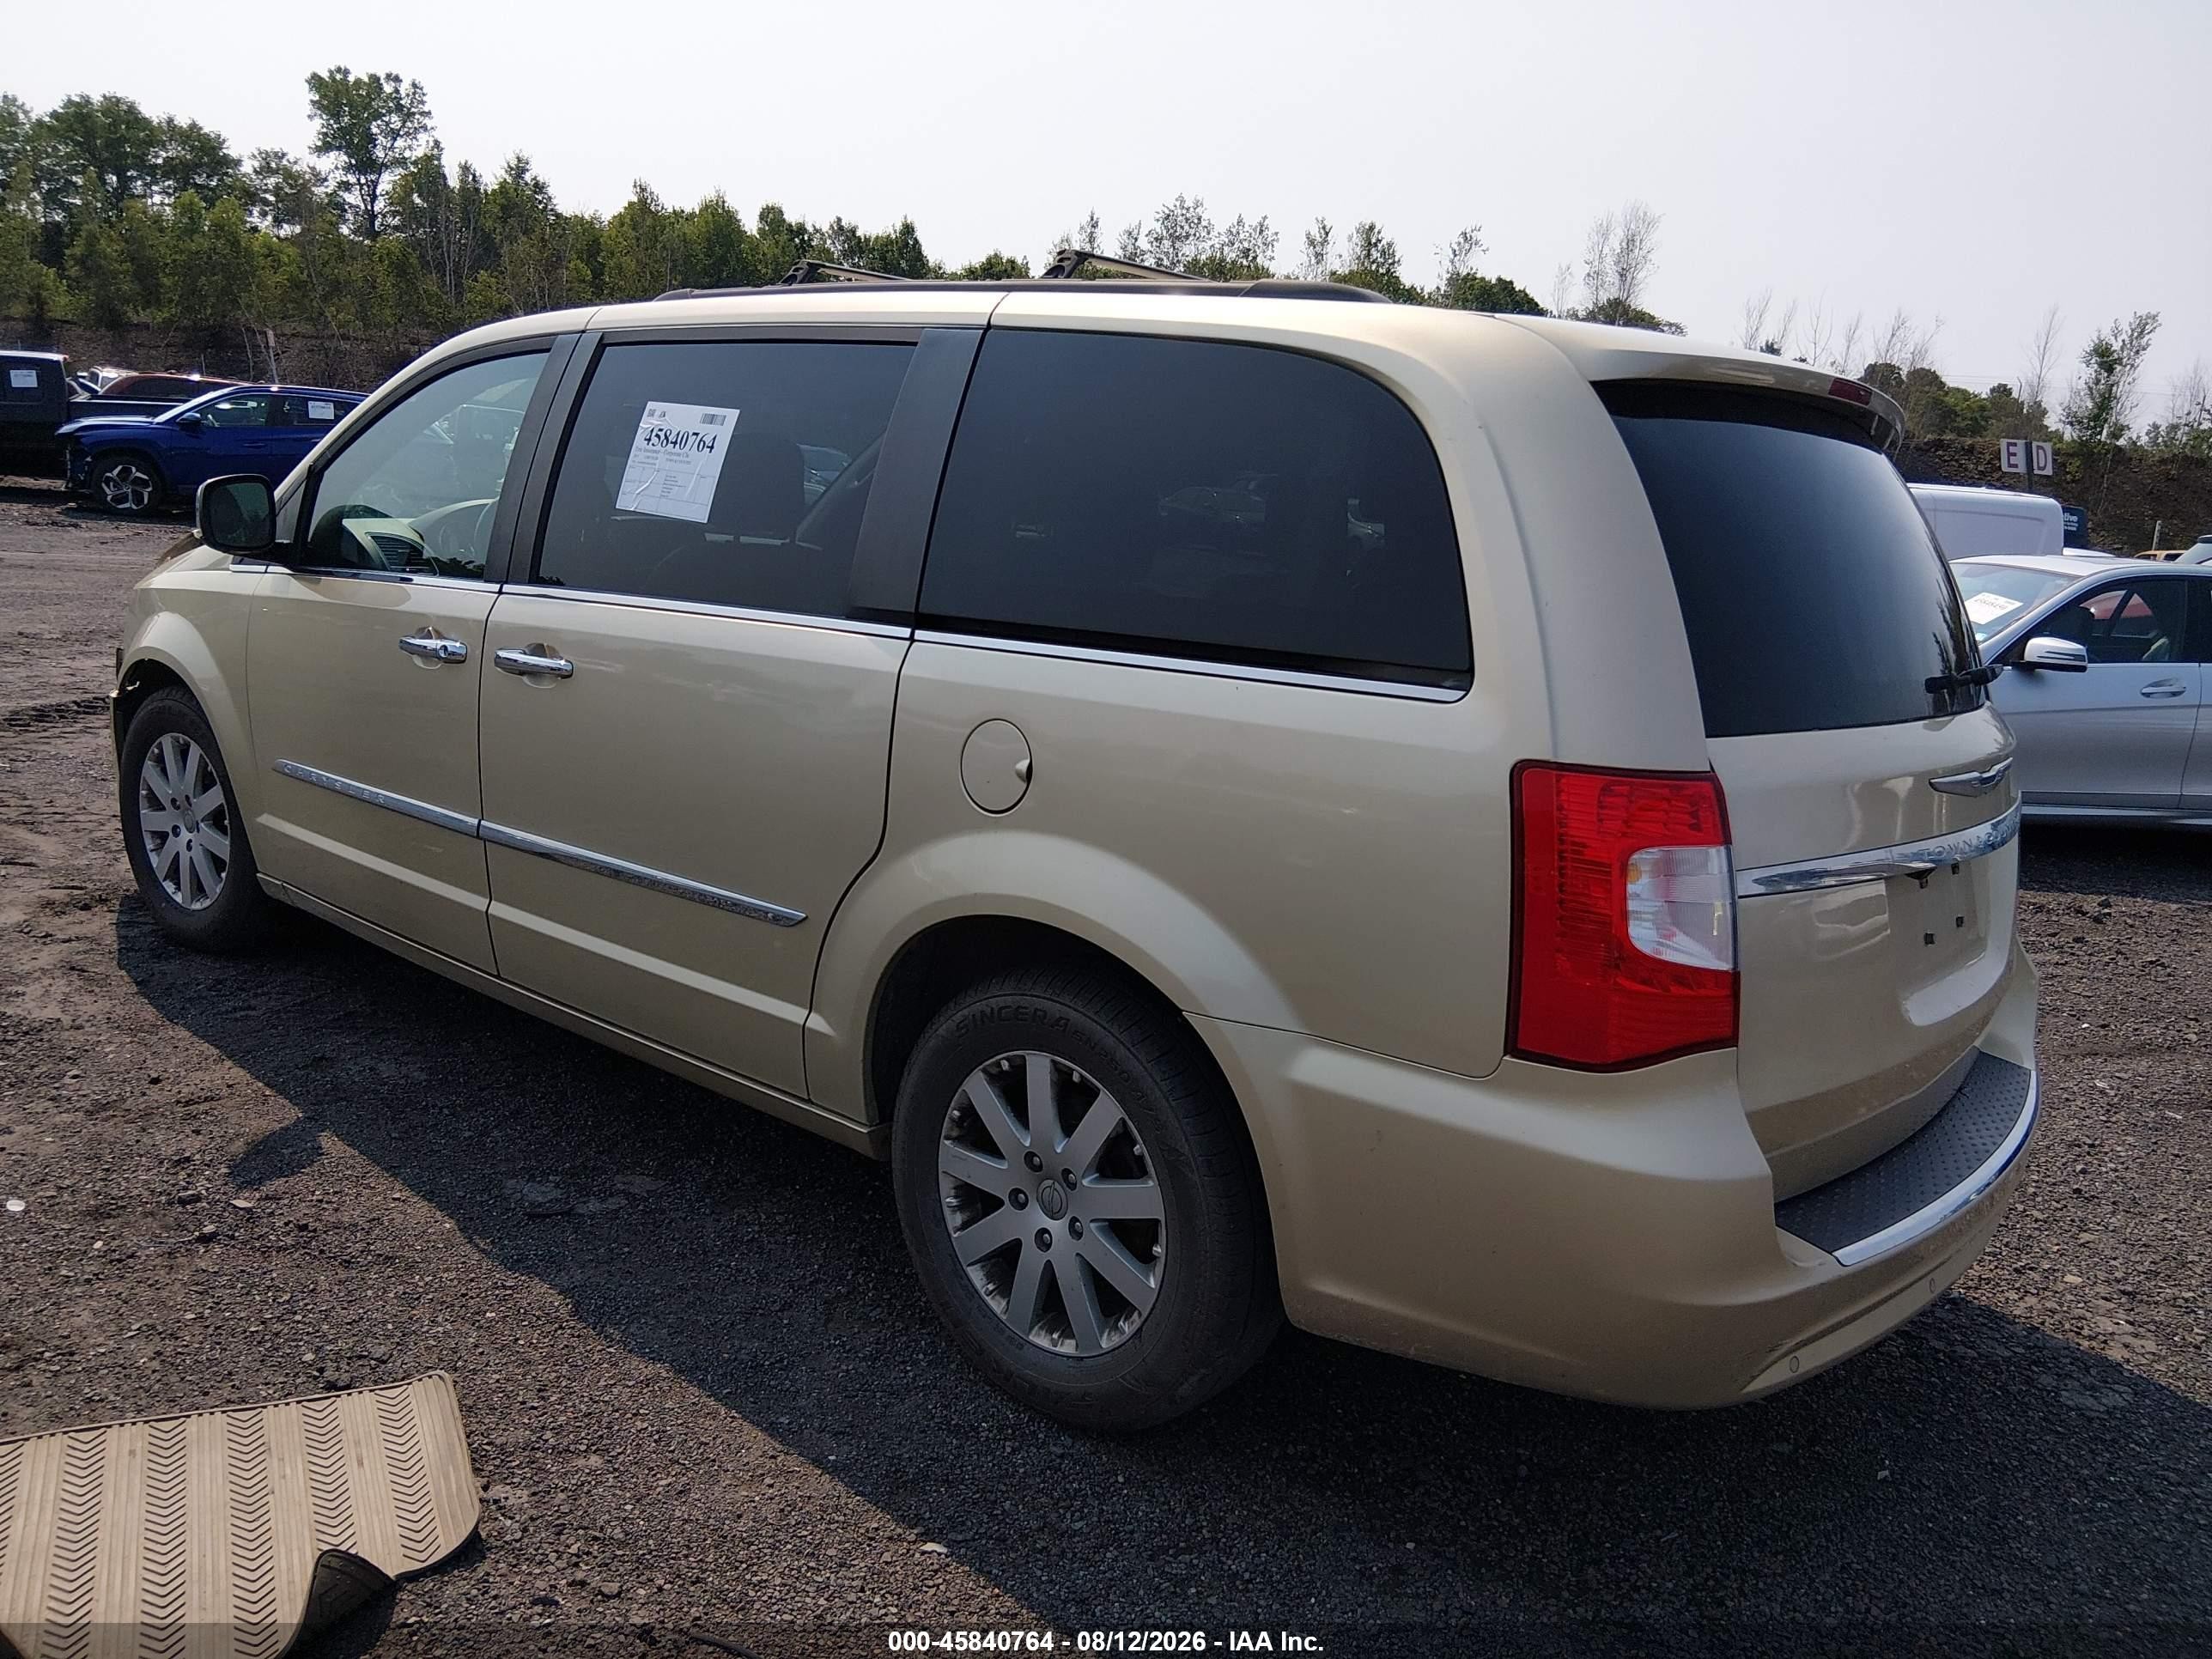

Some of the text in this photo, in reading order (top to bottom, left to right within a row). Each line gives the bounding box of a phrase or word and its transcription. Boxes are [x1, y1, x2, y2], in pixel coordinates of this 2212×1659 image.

[644, 428, 717, 453] 45840764
[2006, 441, 2019, 469] E
[2036, 445, 2048, 471] D
[954, 1005, 1072, 1038] SINCERA
